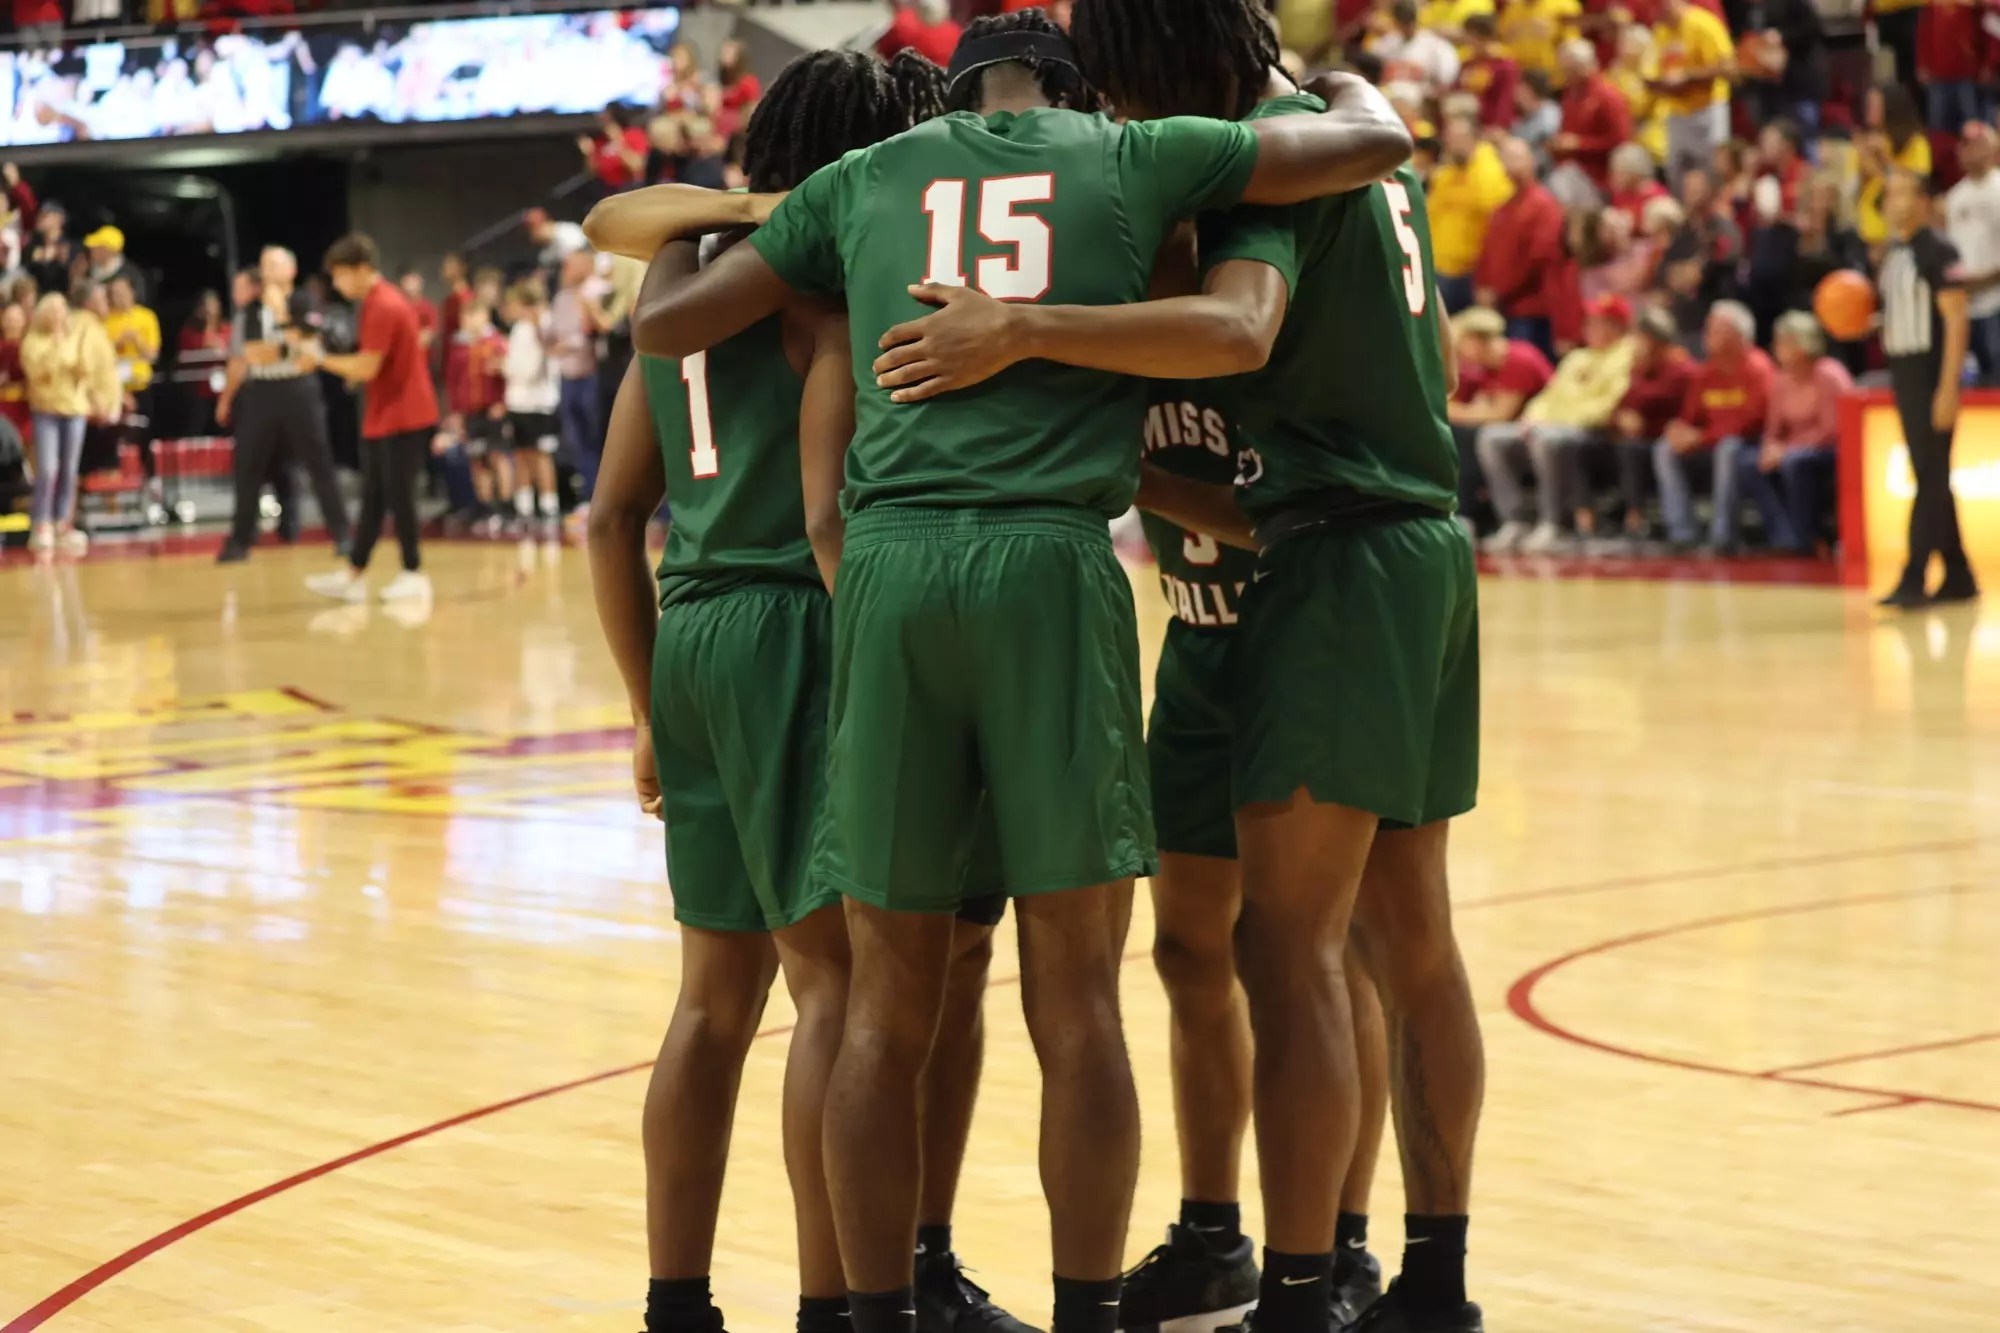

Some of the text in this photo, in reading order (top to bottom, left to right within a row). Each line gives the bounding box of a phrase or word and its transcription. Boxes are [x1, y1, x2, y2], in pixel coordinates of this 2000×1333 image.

[921, 172, 1055, 302] 15
[1380, 178, 1426, 317] 5
[679, 349, 719, 479] 1
[1143, 400, 1230, 457] MISS
